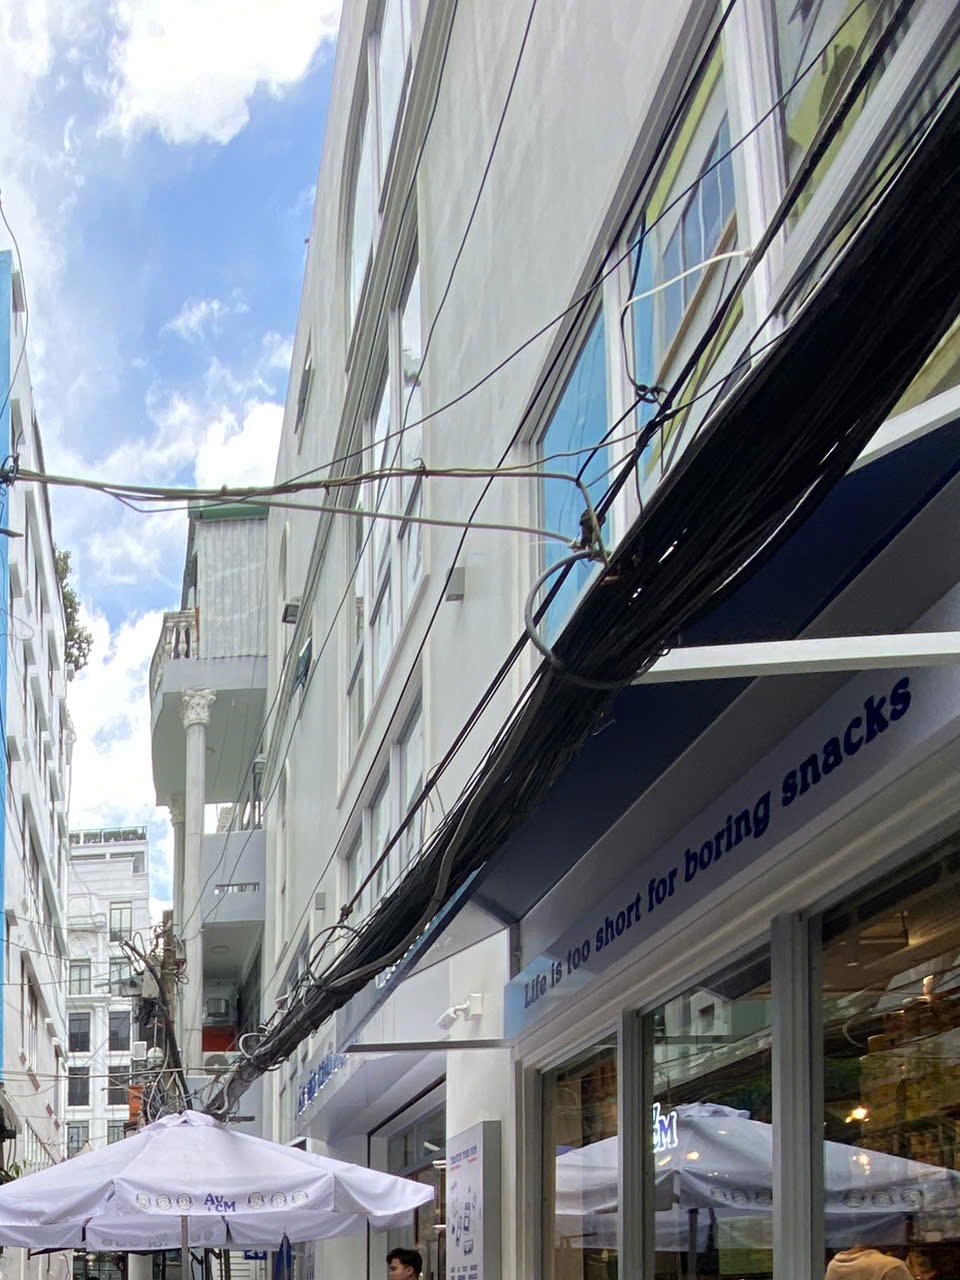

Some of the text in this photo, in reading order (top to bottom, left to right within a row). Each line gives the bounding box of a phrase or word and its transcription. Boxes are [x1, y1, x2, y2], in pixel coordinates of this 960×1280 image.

[524, 676, 911, 1008] Life is too short for boring snacks
